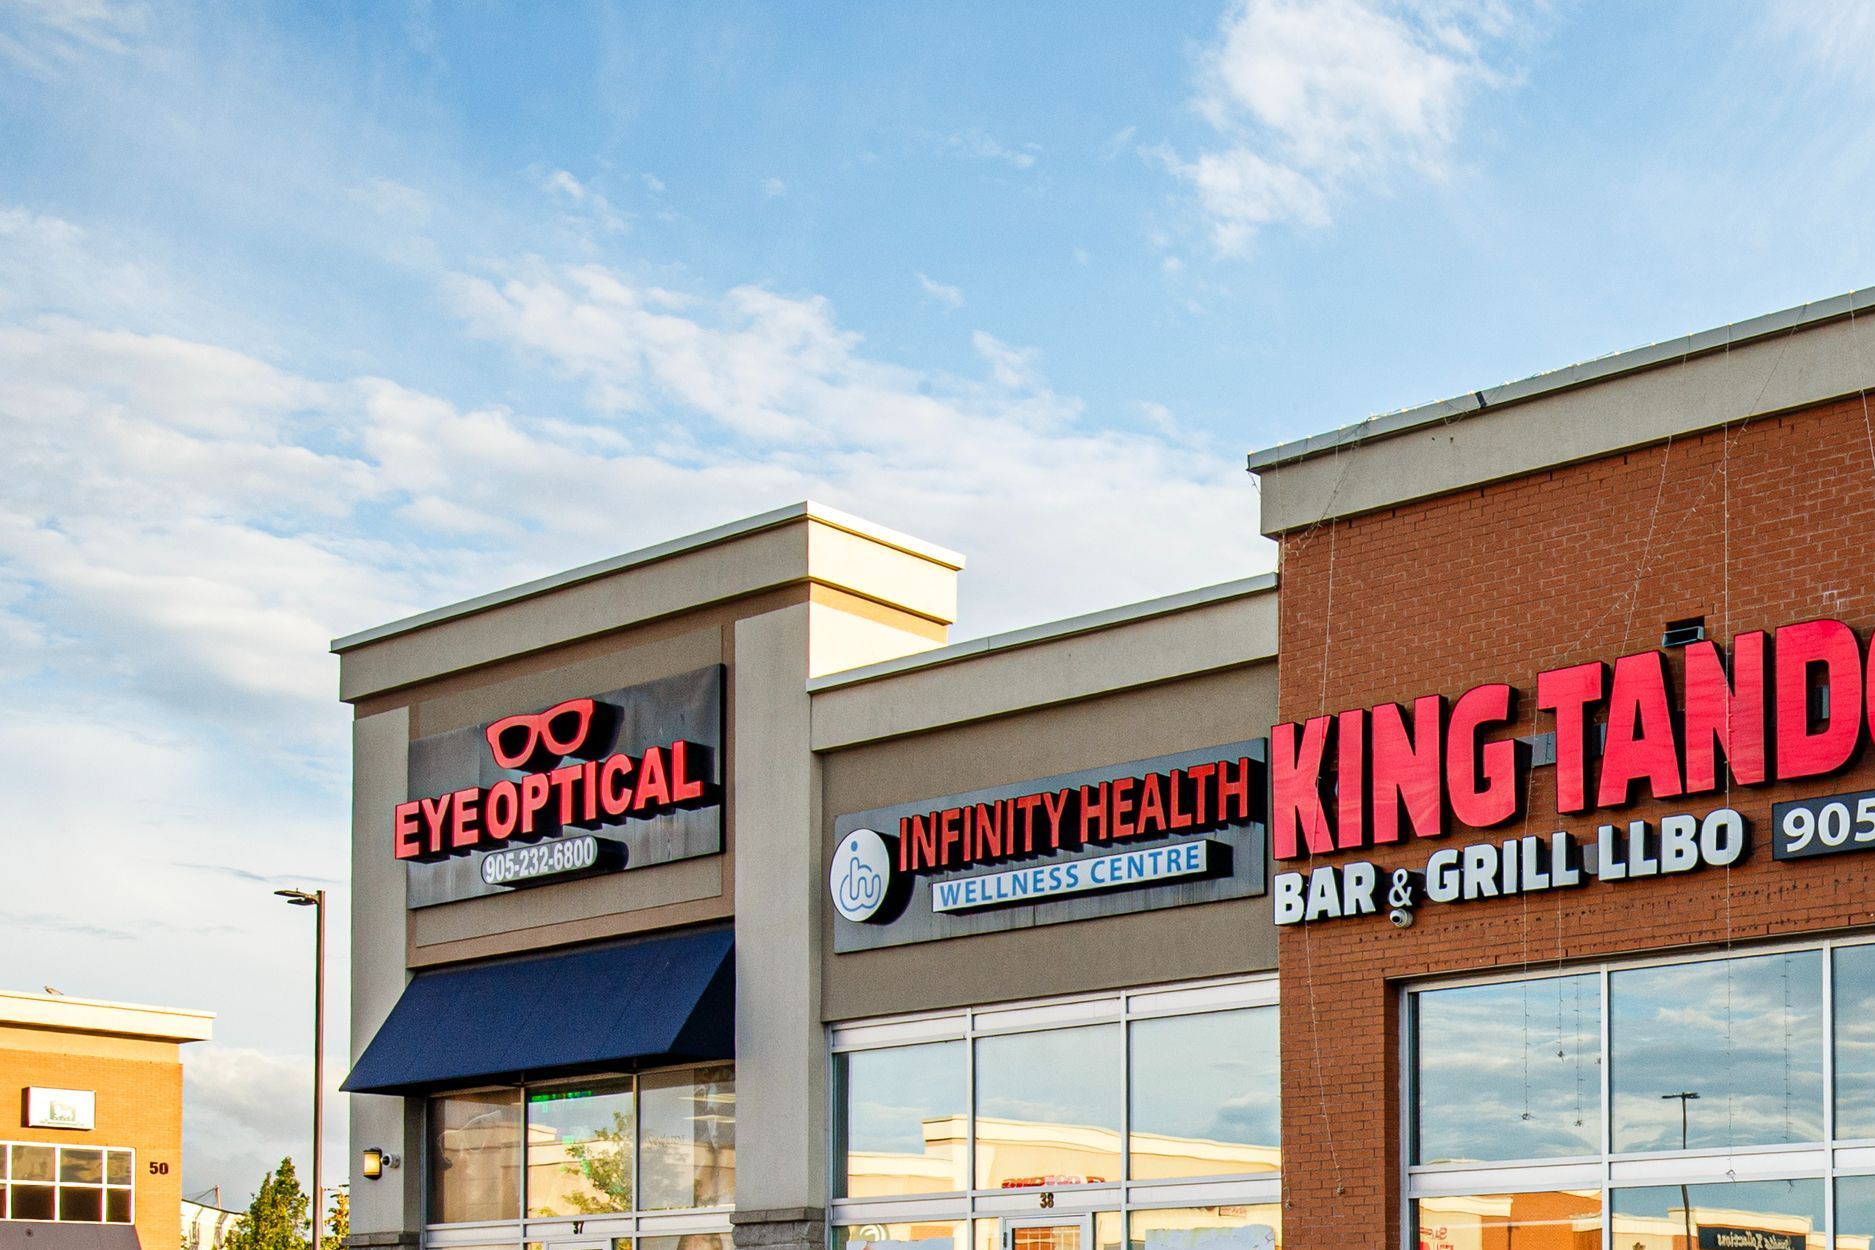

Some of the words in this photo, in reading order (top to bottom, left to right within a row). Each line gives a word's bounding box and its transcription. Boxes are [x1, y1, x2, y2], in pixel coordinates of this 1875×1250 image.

[395, 786, 482, 859] EYE
[485, 739, 704, 840] OPTICAL
[1271, 683, 1517, 860] KING
[900, 788, 1070, 872] INFINITY
[1080, 757, 1249, 844] HEALTH
[485, 835, 595, 883] 905-232-6800
[939, 863, 1080, 907] WELLNESS
[1090, 844, 1201, 884] CENTRE
[1274, 861, 1376, 926] BAR
[1388, 867, 1413, 907] &
[1425, 830, 1580, 903] GRILL
[1598, 807, 1745, 881] LLBO
[149, 1161, 169, 1175] 50
[573, 1221, 585, 1234] 37
[1039, 1191, 1055, 1209] 38
